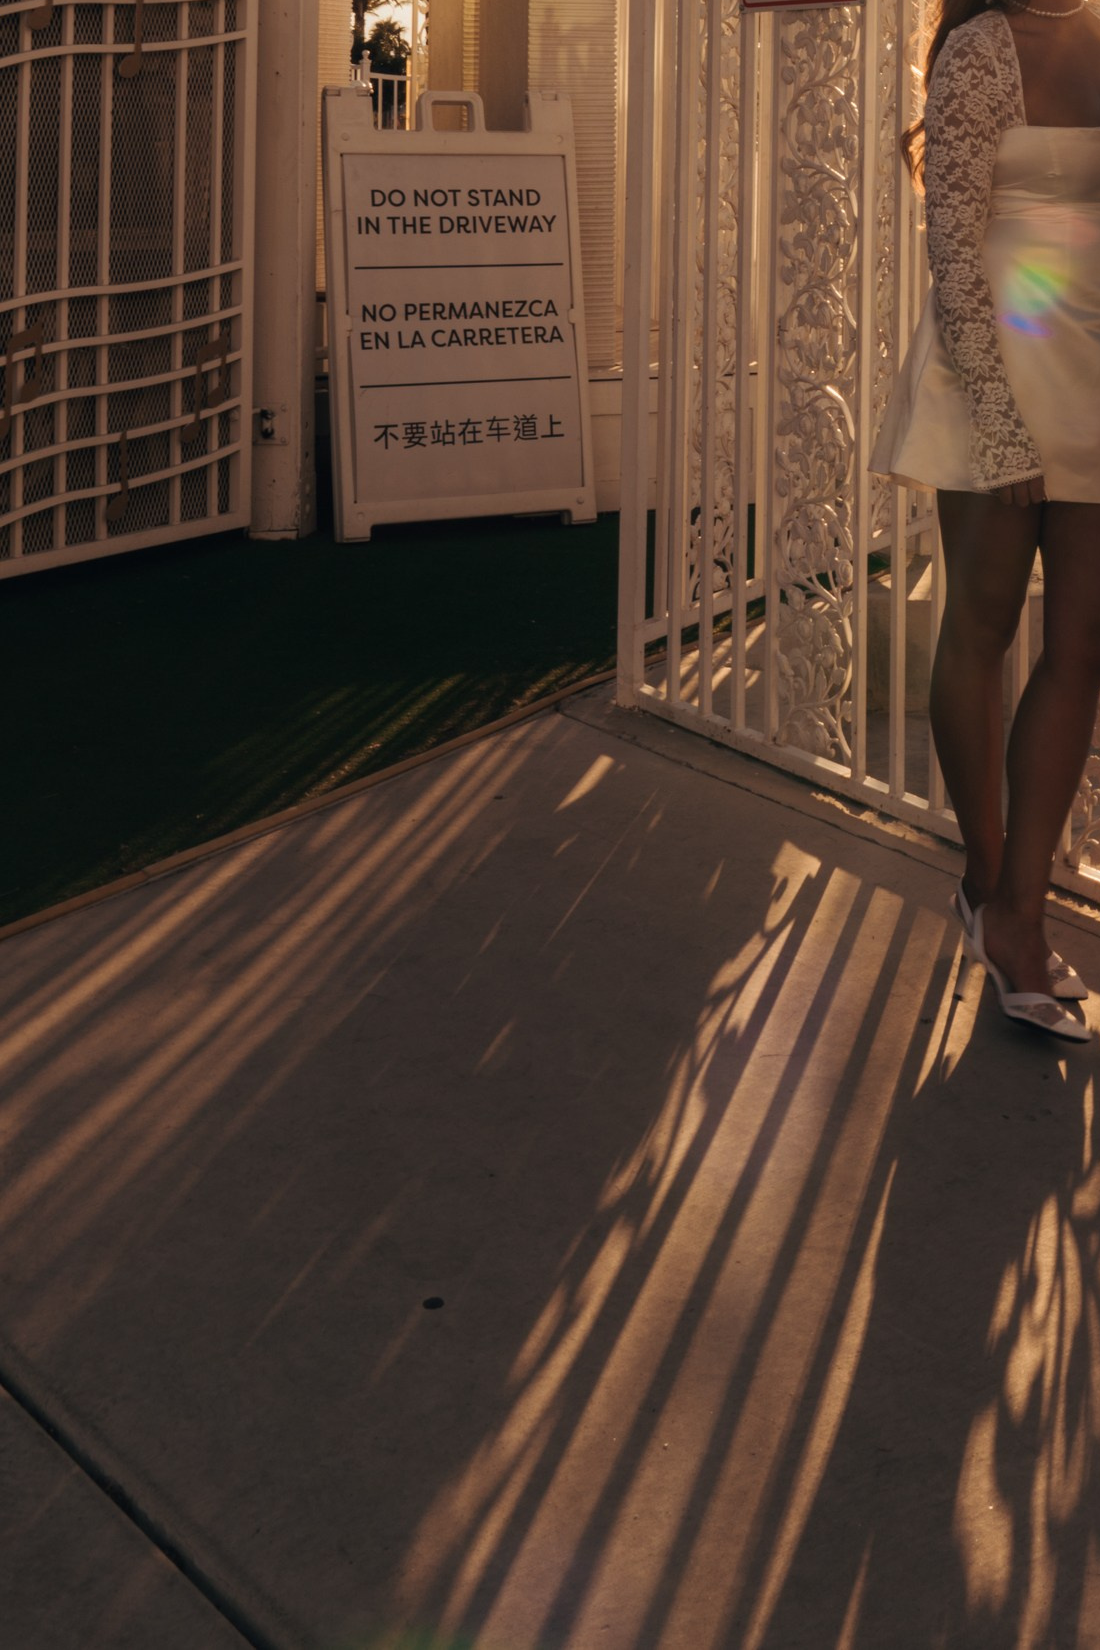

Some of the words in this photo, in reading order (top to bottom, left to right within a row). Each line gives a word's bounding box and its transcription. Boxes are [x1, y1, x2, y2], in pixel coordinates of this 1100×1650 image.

[370, 189, 405, 208] DO
[413, 189, 461, 207] NOT
[467, 188, 541, 207] STAND
[357, 216, 380, 235] IN
[387, 216, 432, 234] THE
[439, 215, 557, 234] DRIVEWAY
[361, 304, 396, 323] NO
[404, 299, 558, 321] PERMANEZCA
[360, 331, 390, 350] EN
[398, 330, 426, 349] LA
[431, 325, 564, 348] CARRETERA
[373, 414, 565, 449] 不要站在车道上
